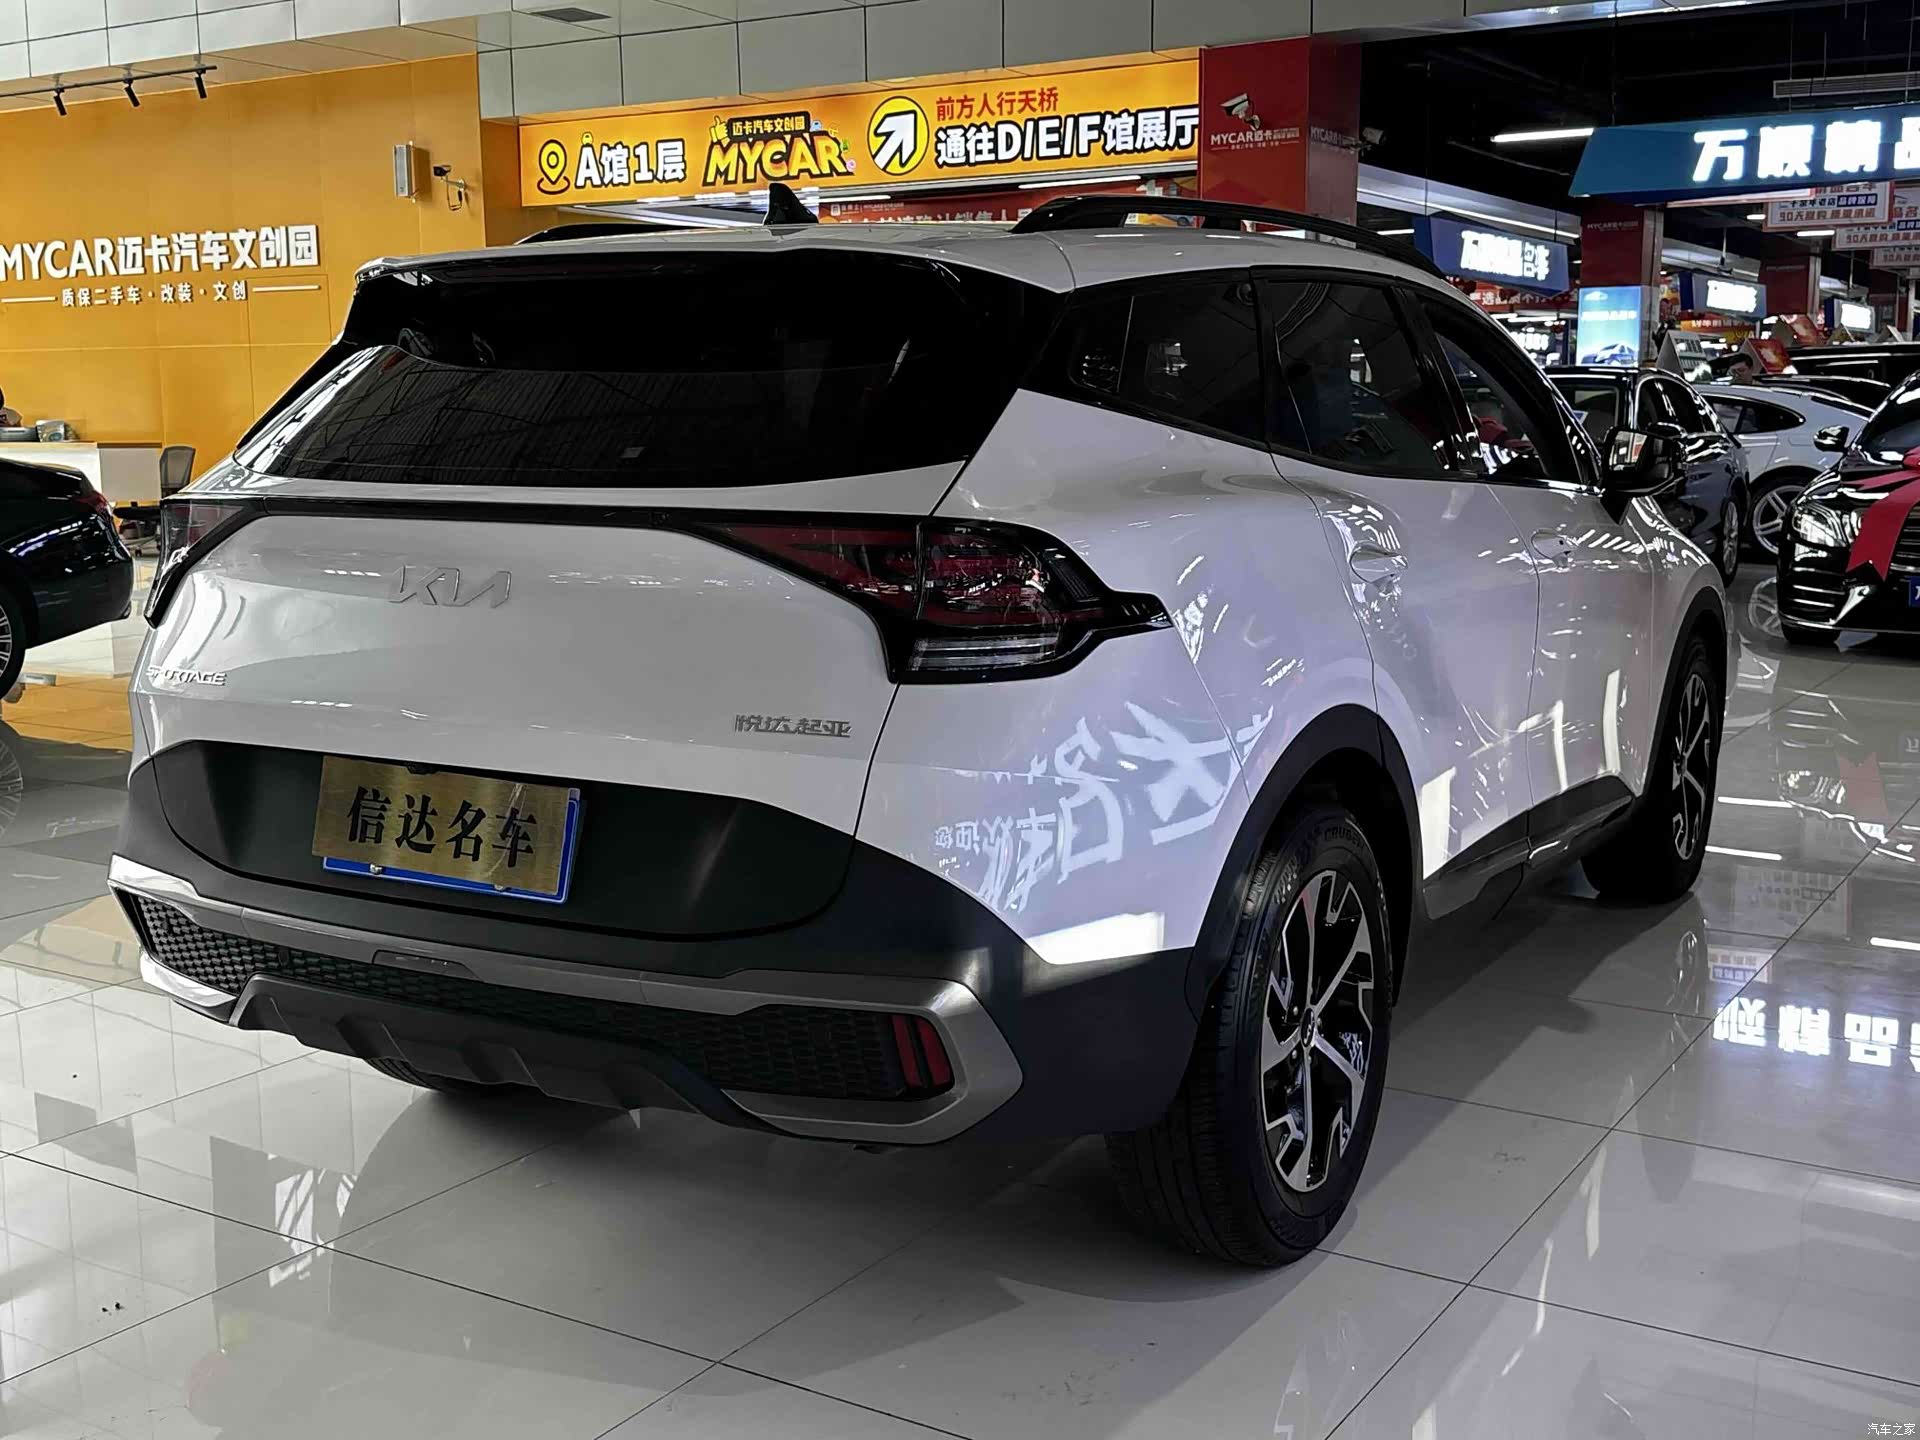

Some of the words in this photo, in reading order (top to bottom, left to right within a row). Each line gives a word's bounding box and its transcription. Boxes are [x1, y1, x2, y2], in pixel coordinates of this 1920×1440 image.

[732, 115, 806, 136] 迈卡汽车文创园
[935, 87, 1059, 121] 前方人行天桥
[704, 135, 851, 184] MYCAR
[935, 107, 1199, 165] 通往D/E/F馆展厅
[576, 140, 687, 188] A馆1层
[0, 224, 319, 282] MYCAR迈卡汽车文创园
[387, 565, 512, 608] KIA
[735, 714, 853, 738] 悦达起亚
[347, 785, 537, 868] 信达名车
